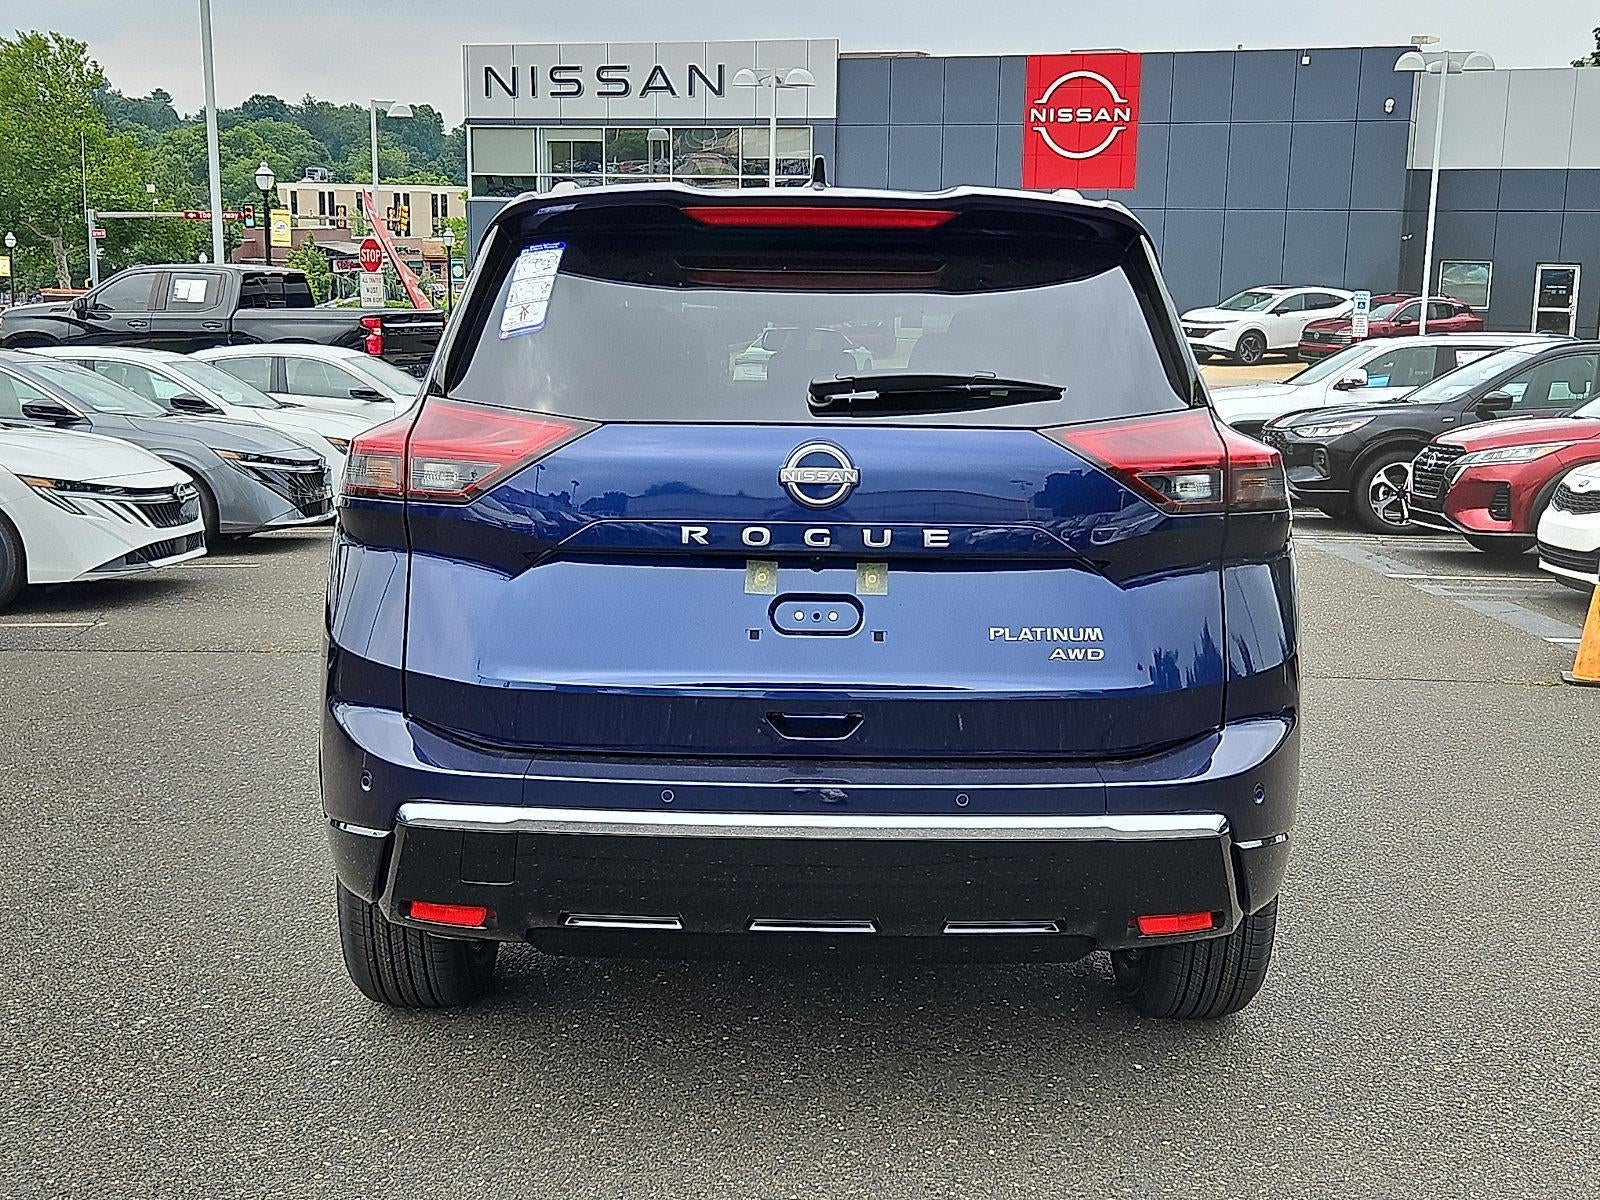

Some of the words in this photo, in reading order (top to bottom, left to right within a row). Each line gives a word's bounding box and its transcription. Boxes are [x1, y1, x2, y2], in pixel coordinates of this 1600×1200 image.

[484, 64, 726, 98] NISSAN
[1029, 107, 1132, 123] NISSAN
[361, 248, 381, 263] STOP
[783, 471, 856, 482] NISSAN
[681, 525, 951, 548] ROGUE
[988, 627, 1104, 641] PLATINUM
[1048, 648, 1105, 661] AWD
